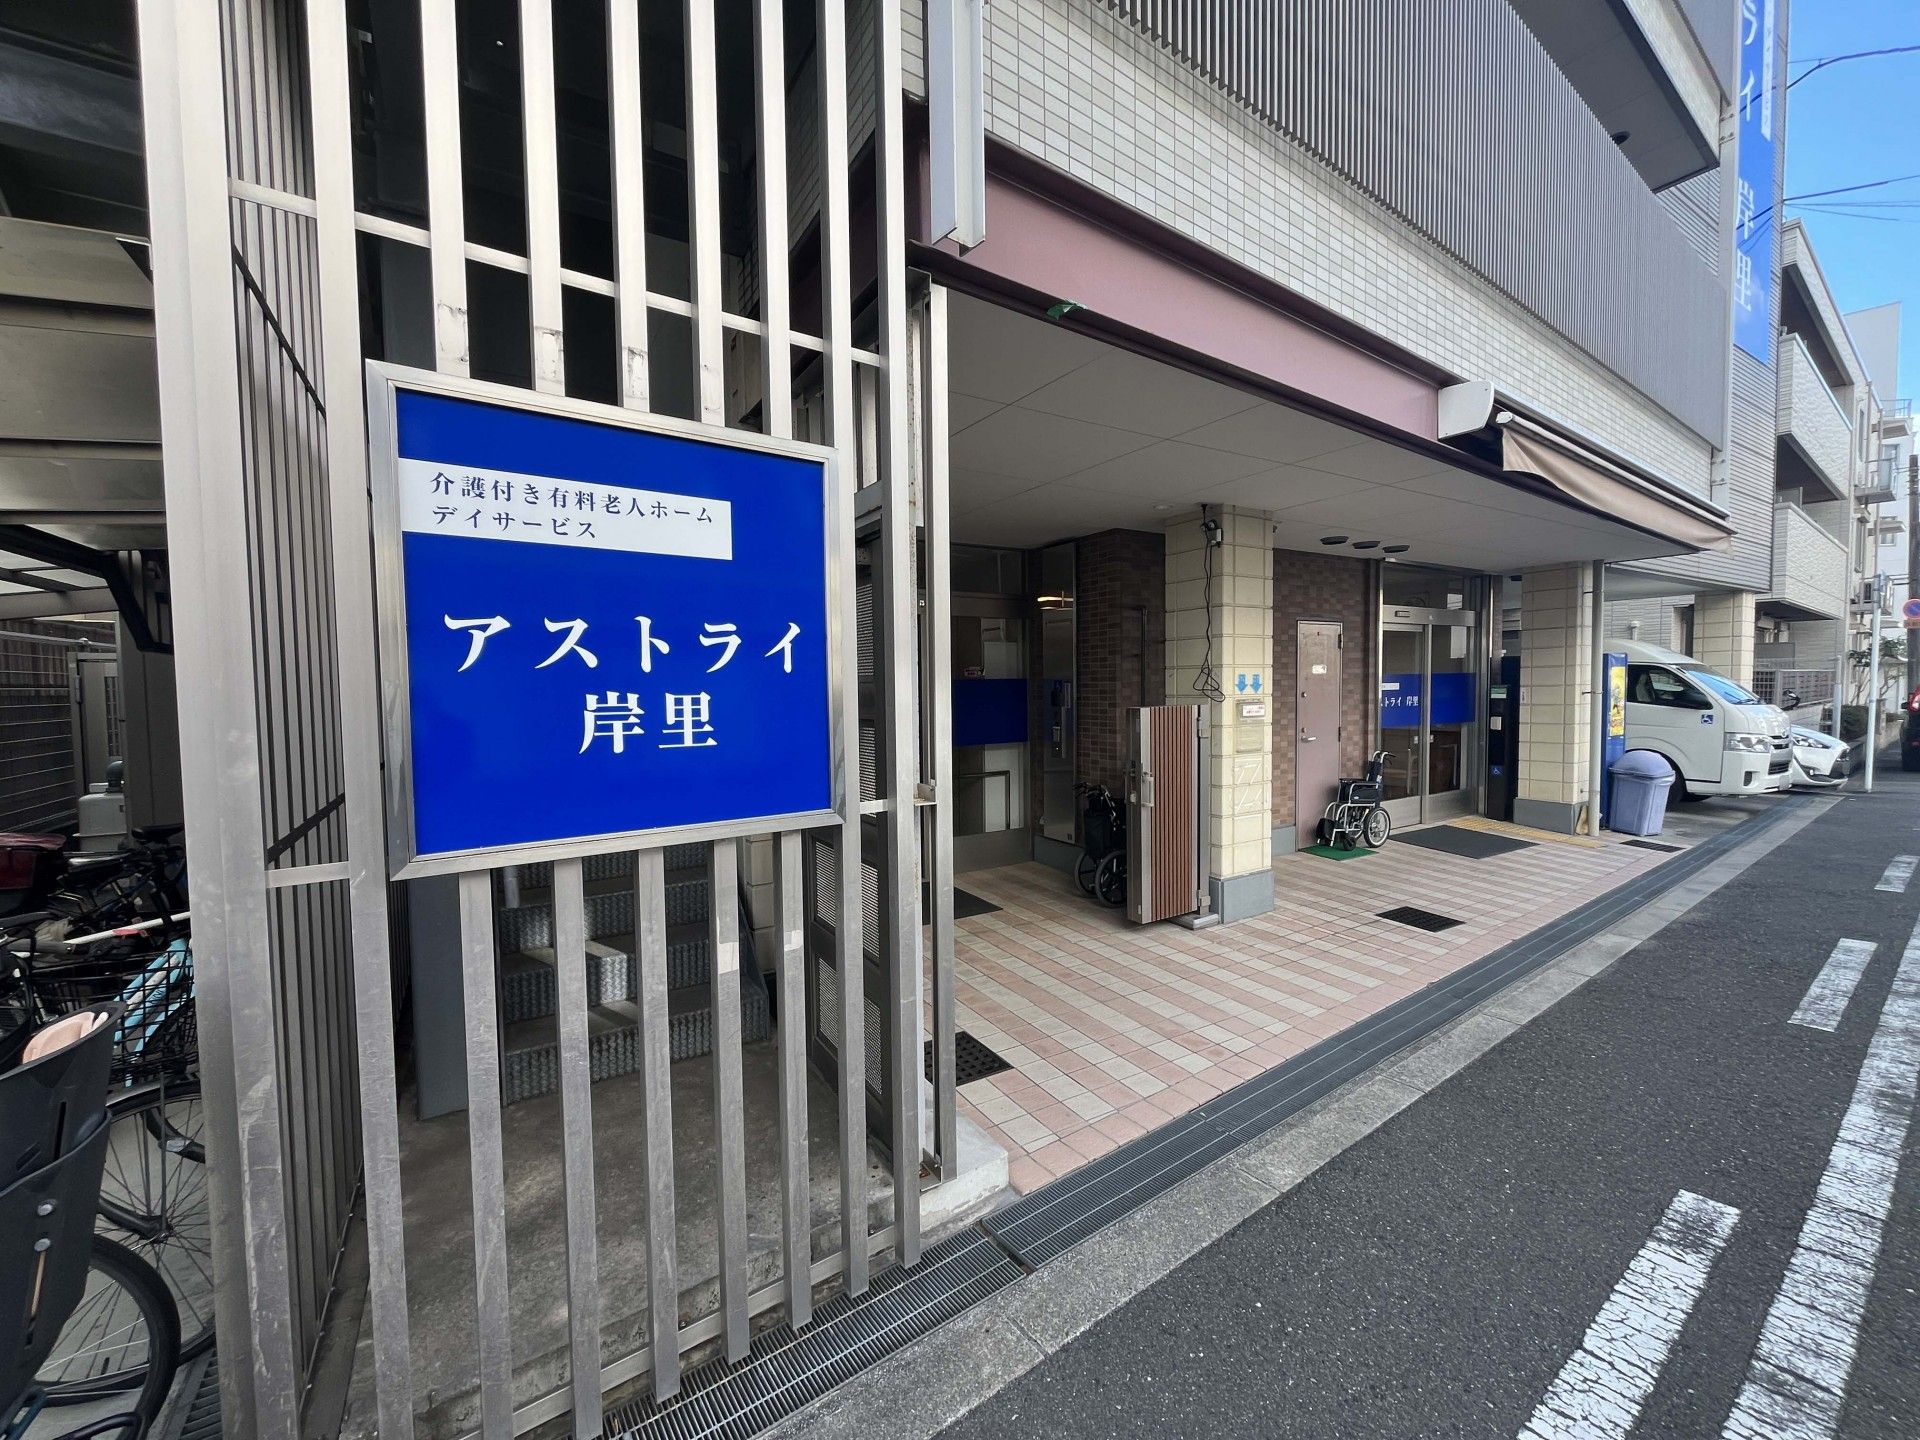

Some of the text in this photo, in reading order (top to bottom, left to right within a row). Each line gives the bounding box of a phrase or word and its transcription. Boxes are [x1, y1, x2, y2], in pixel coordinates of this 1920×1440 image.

[431, 471, 714, 525] 介護付き有料老人ホーム
[432, 505, 598, 540] デイサービス
[444, 614, 801, 674] アストライ
[579, 690, 718, 754] 岸里
